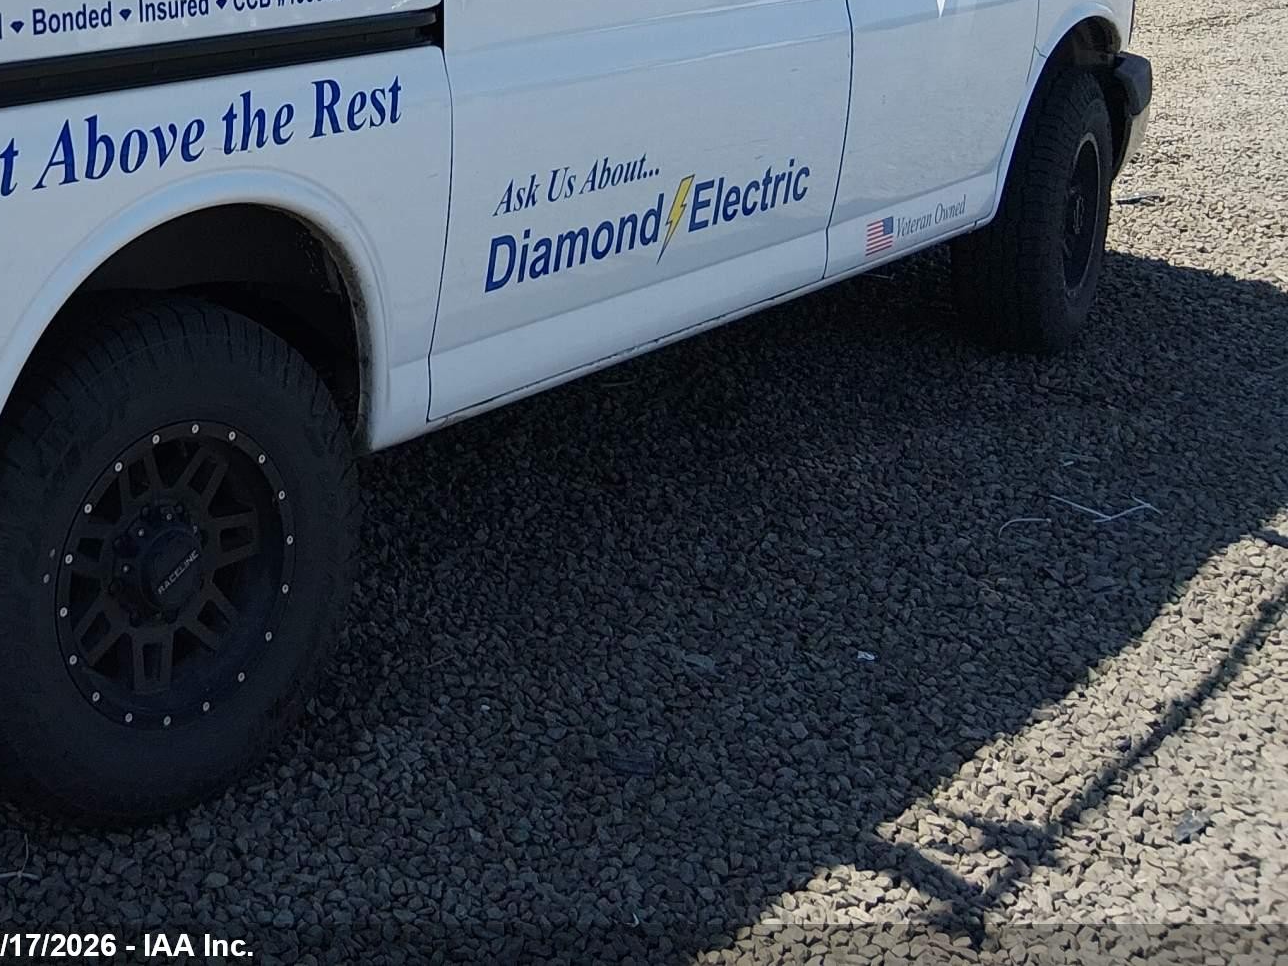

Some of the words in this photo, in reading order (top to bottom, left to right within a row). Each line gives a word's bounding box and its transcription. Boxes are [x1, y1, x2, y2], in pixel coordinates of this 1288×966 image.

[32, 1, 113, 35] Bonded
[32, 114, 206, 190] Above
[222, 90, 294, 156] the
[310, 75, 402, 140] Rest
[493, 178, 541, 217] Ask
[547, 166, 576, 202] Us
[580, 153, 660, 196] About...
[485, 194, 665, 294] Diamond
[688, 158, 811, 234] Electric
[896, 212, 933, 238] Veteran
[934, 194, 967, 224] Owned
[157, 548, 200, 595] RACELINE
